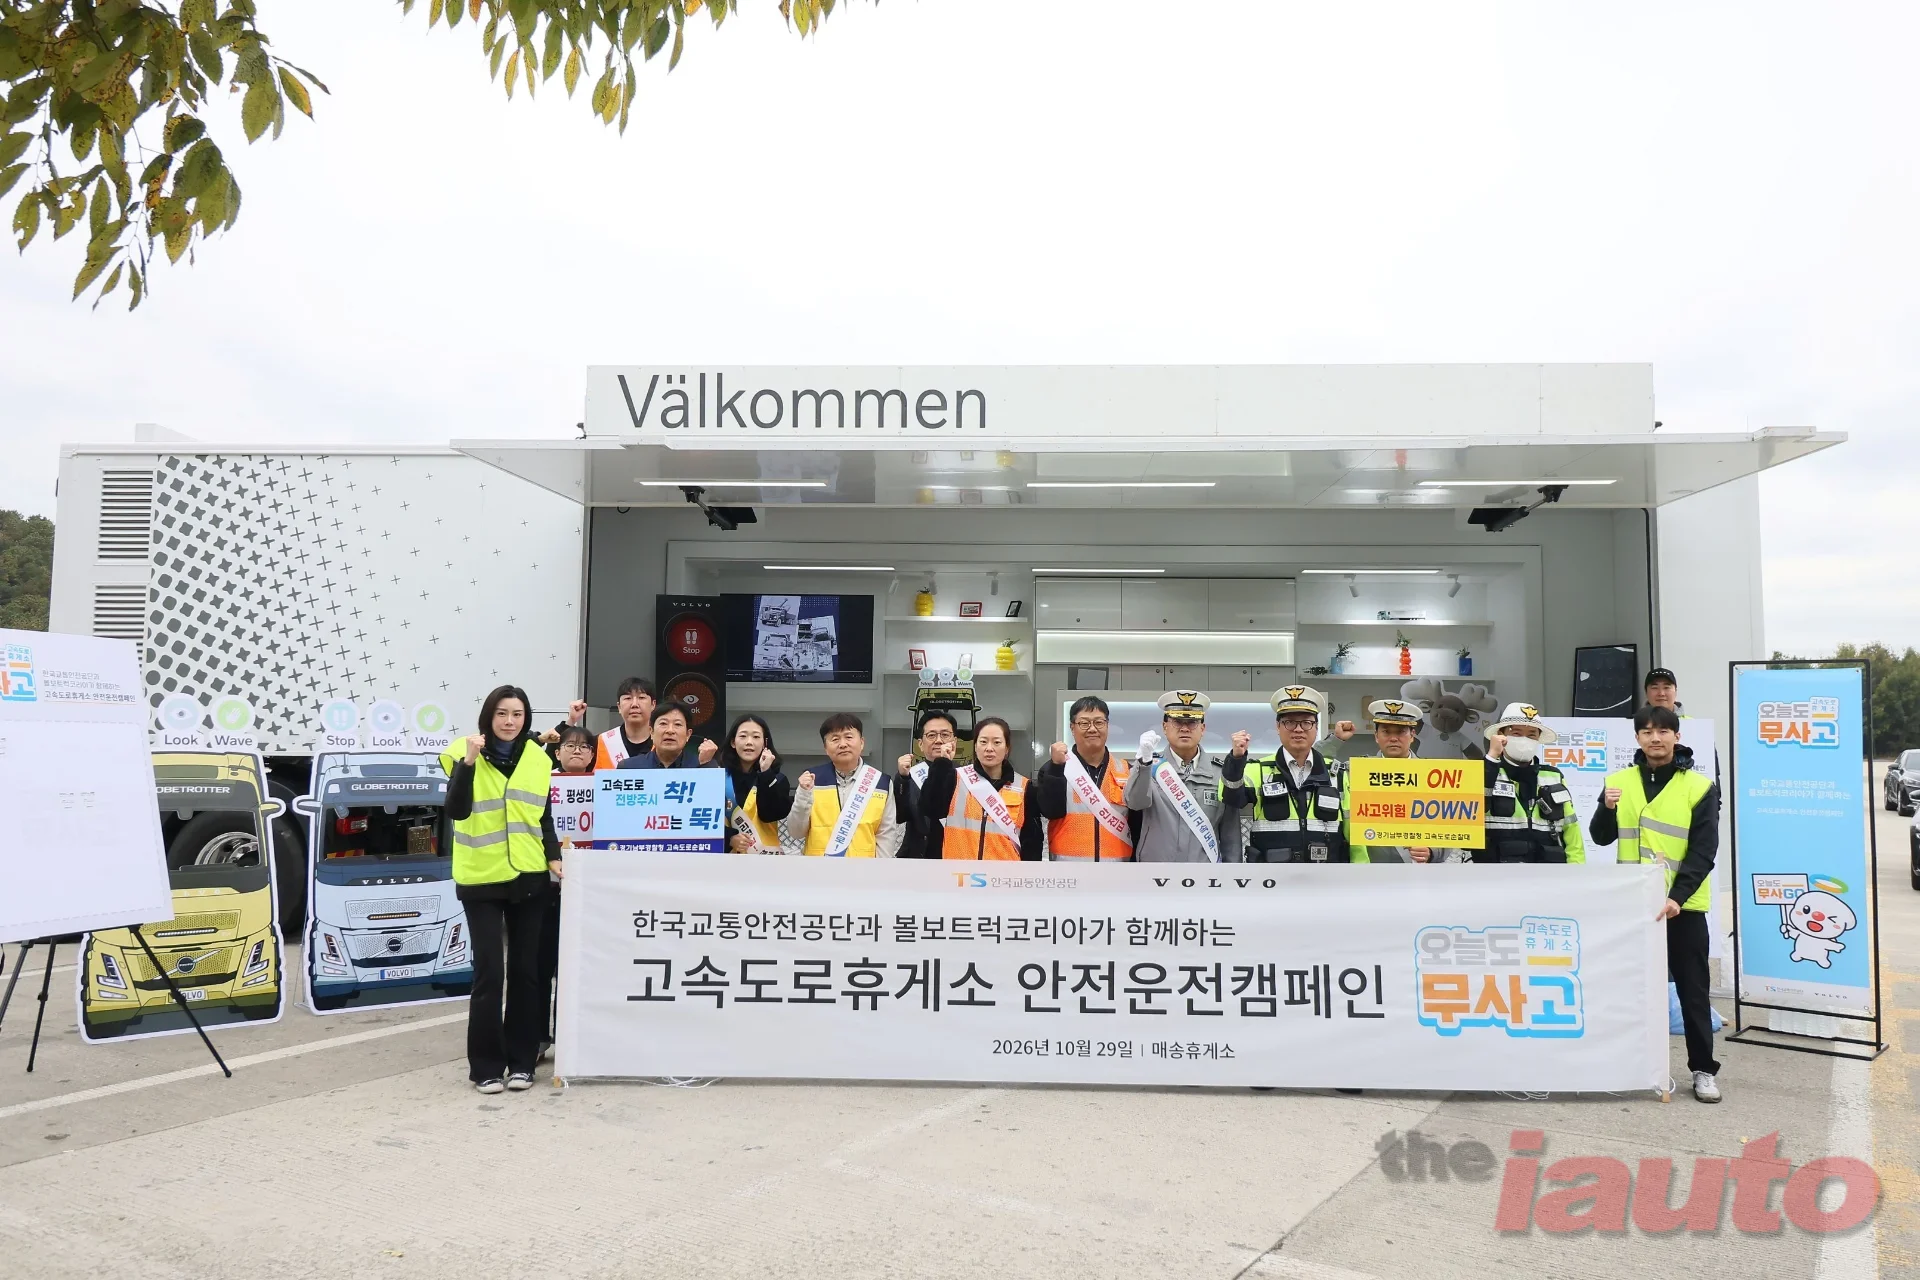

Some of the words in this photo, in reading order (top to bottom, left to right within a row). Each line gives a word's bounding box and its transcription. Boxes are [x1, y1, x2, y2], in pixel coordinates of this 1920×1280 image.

[617, 372, 986, 429] Välkommen
[682, 646, 701, 655] Stop
[44, 690, 91, 700] 고속도로휴게소
[1760, 703, 1809, 718] 오늘도
[1760, 721, 1836, 743] 무사고
[164, 734, 198, 745] Look
[214, 735, 253, 746] Wave
[326, 735, 356, 748] Stop
[372, 736, 402, 747] Look
[415, 736, 449, 747] Wave
[1553, 733, 1584, 746] 늘도
[1544, 748, 1606, 768] 무사고
[601, 779, 644, 791] 고속도로
[1369, 772, 1418, 787] 전방주시
[1427, 769, 1463, 788] ON!
[156, 786, 230, 794] OBETROTTER
[351, 783, 429, 791] GLOBETROTTER
[664, 781, 696, 804] 착!
[615, 793, 658, 806] 전방주시
[1356, 803, 1406, 818] 사고위험
[1410, 799, 1479, 820] DOWN!
[644, 815, 682, 830] 사고는
[689, 807, 722, 831] 뚝!
[1424, 832, 1471, 841] 고속도로순찰대
[362, 876, 423, 885] VOLVO
[951, 872, 987, 888] TS
[990, 876, 1078, 889] 한국교통안전공단
[1152, 877, 1277, 889] VOLVO
[1757, 879, 1781, 887] 오늘도
[632, 909, 882, 943] 한국교통안전공단과
[892, 913, 1115, 946] 볼보트럭코리아가
[1125, 916, 1236, 947] 함께하는
[1525, 922, 1572, 937] 고속도로
[1420, 932, 1521, 966] 오늘도
[1525, 937, 1573, 951] 휴게소
[386, 969, 410, 978] VOLVO
[626, 954, 997, 1012] 고속도로휴게소
[1017, 959, 1385, 1020] 안전운전캠페인
[183, 990, 203, 1000] OLVO
[1421, 973, 1577, 1024] 무사고
[992, 1038, 1049, 1057] 2026년
[1055, 1039, 1092, 1058] 10월
[1096, 1040, 1133, 1058] 29일
[1152, 1041, 1236, 1061] 매송휴게소
